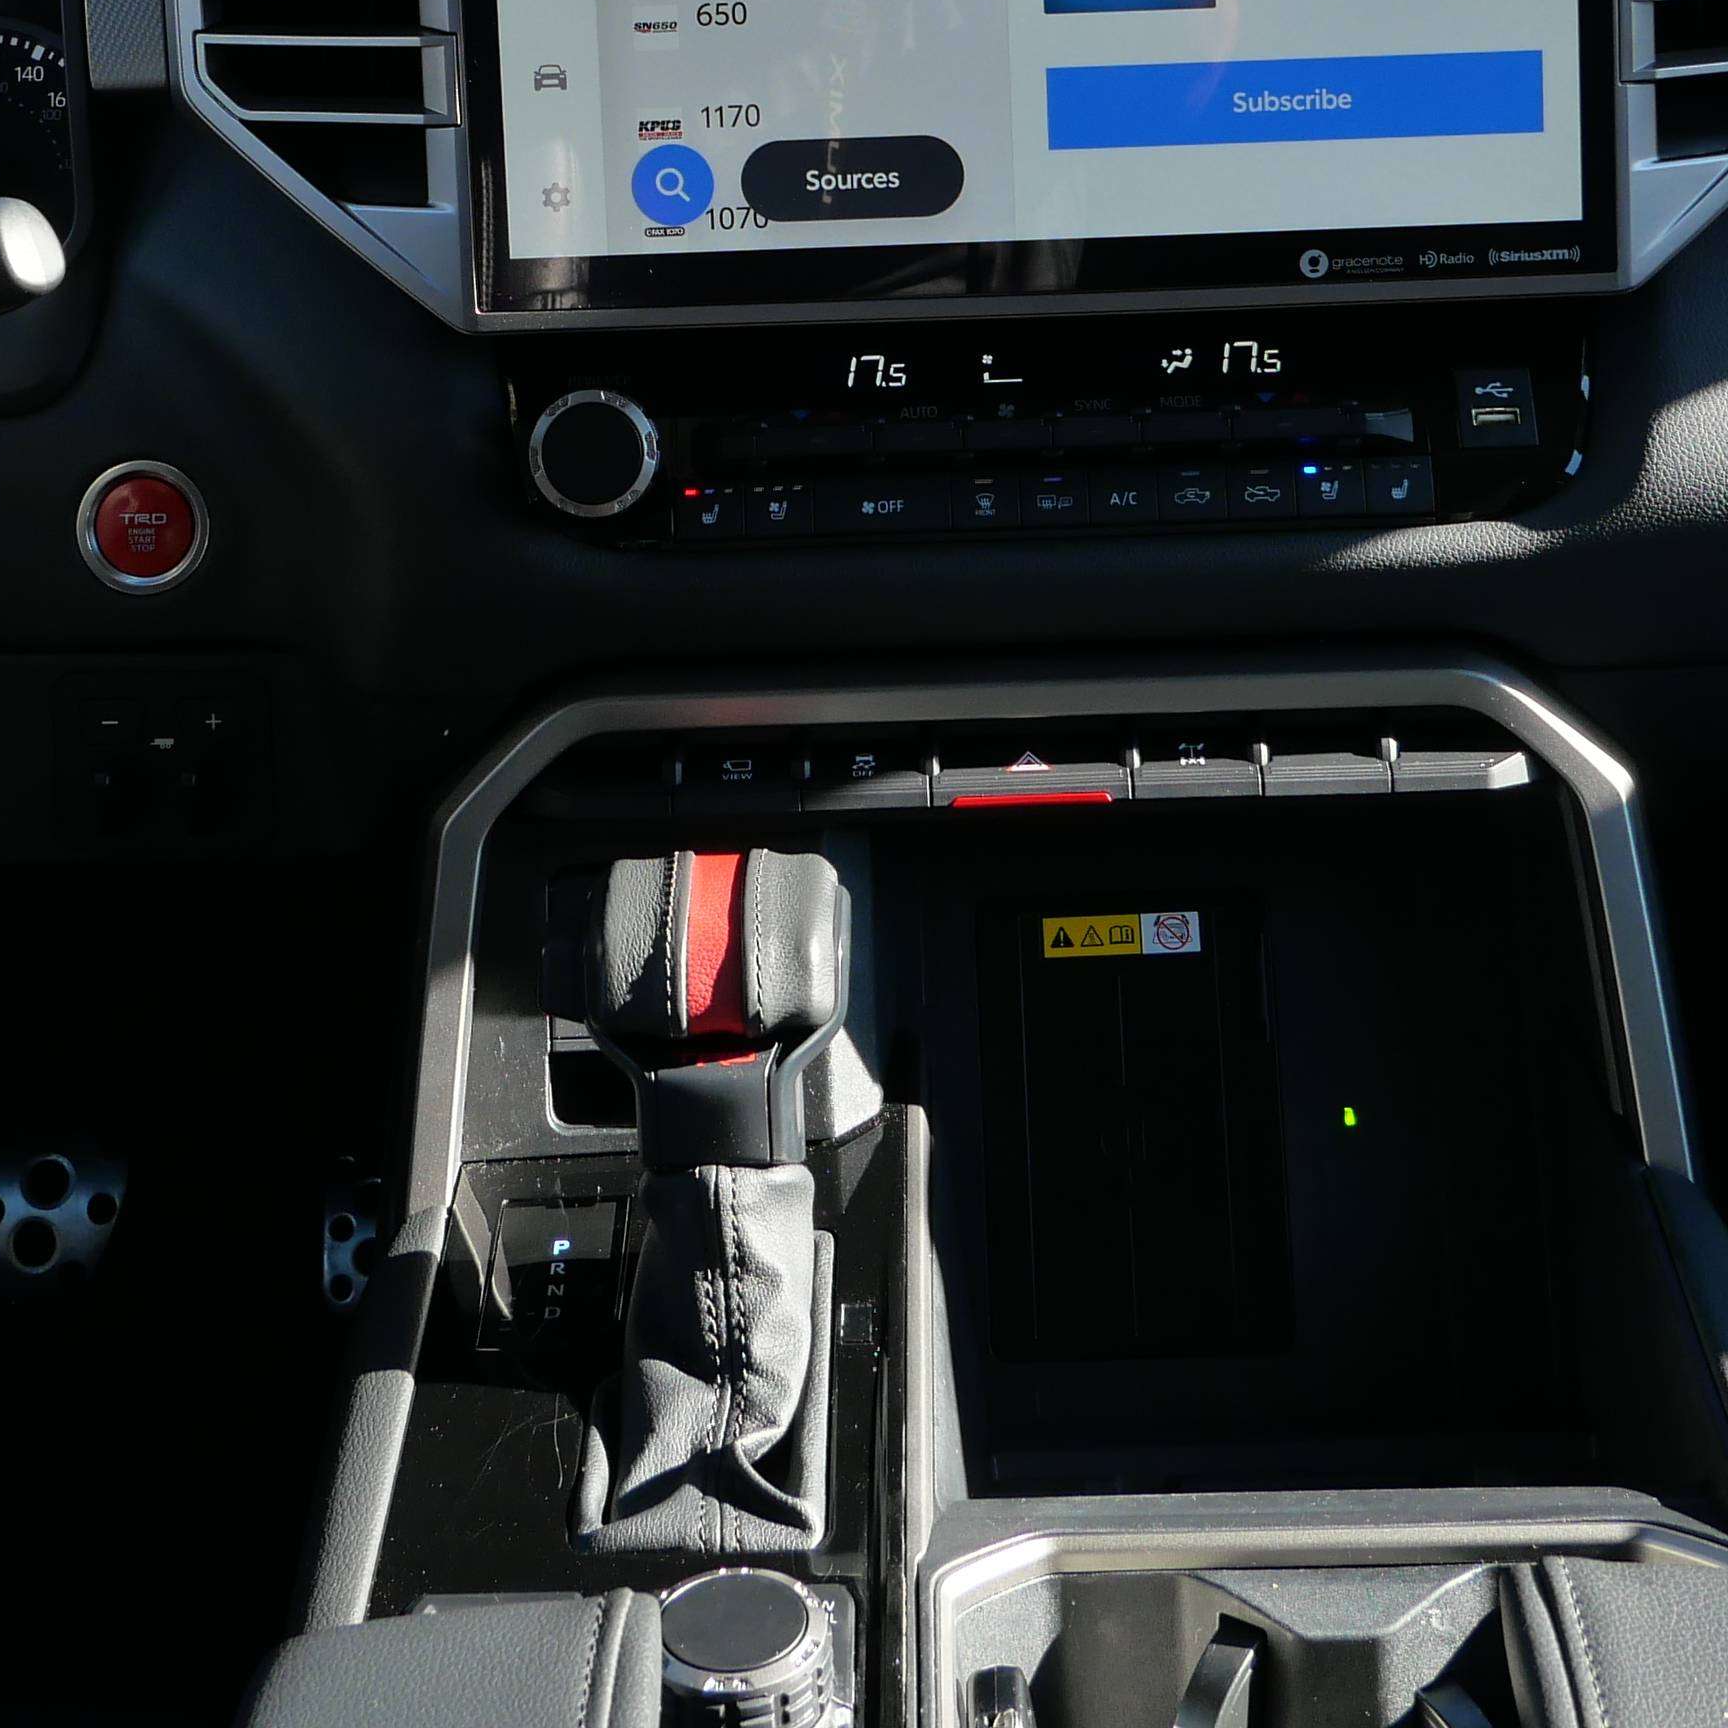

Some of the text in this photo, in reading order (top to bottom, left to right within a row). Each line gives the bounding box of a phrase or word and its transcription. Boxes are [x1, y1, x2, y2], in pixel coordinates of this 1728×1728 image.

[695, 2, 747, 26] 650
[633, 21, 678, 30] SN650
[14, 65, 45, 82] 140
[47, 91, 67, 108] 16
[1232, 89, 1352, 114] Subscribe
[700, 104, 761, 128] 1170
[805, 170, 900, 191] Sources
[705, 207, 769, 230] 1070
[1332, 255, 1403, 270] gracenote
[1440, 252, 1474, 265] Radio
[1223, 341, 1282, 373] 17.5
[848, 355, 907, 387] 17.5
[1074, 399, 1112, 412] SYNC
[1160, 394, 1202, 408] MODE
[900, 405, 938, 419] AUTO
[1110, 491, 1139, 506] A/C
[877, 500, 905, 514] OFF
[120, 513, 167, 525] TRD
[128, 528, 156, 536] ENGINE
[128, 536, 156, 544] START
[130, 544, 156, 552] STOP
[722, 773, 753, 781] VIEW
[553, 1240, 570, 1255] P
[550, 1262, 565, 1275] R
[547, 1284, 565, 1296] N
[543, 1306, 561, 1319] D
